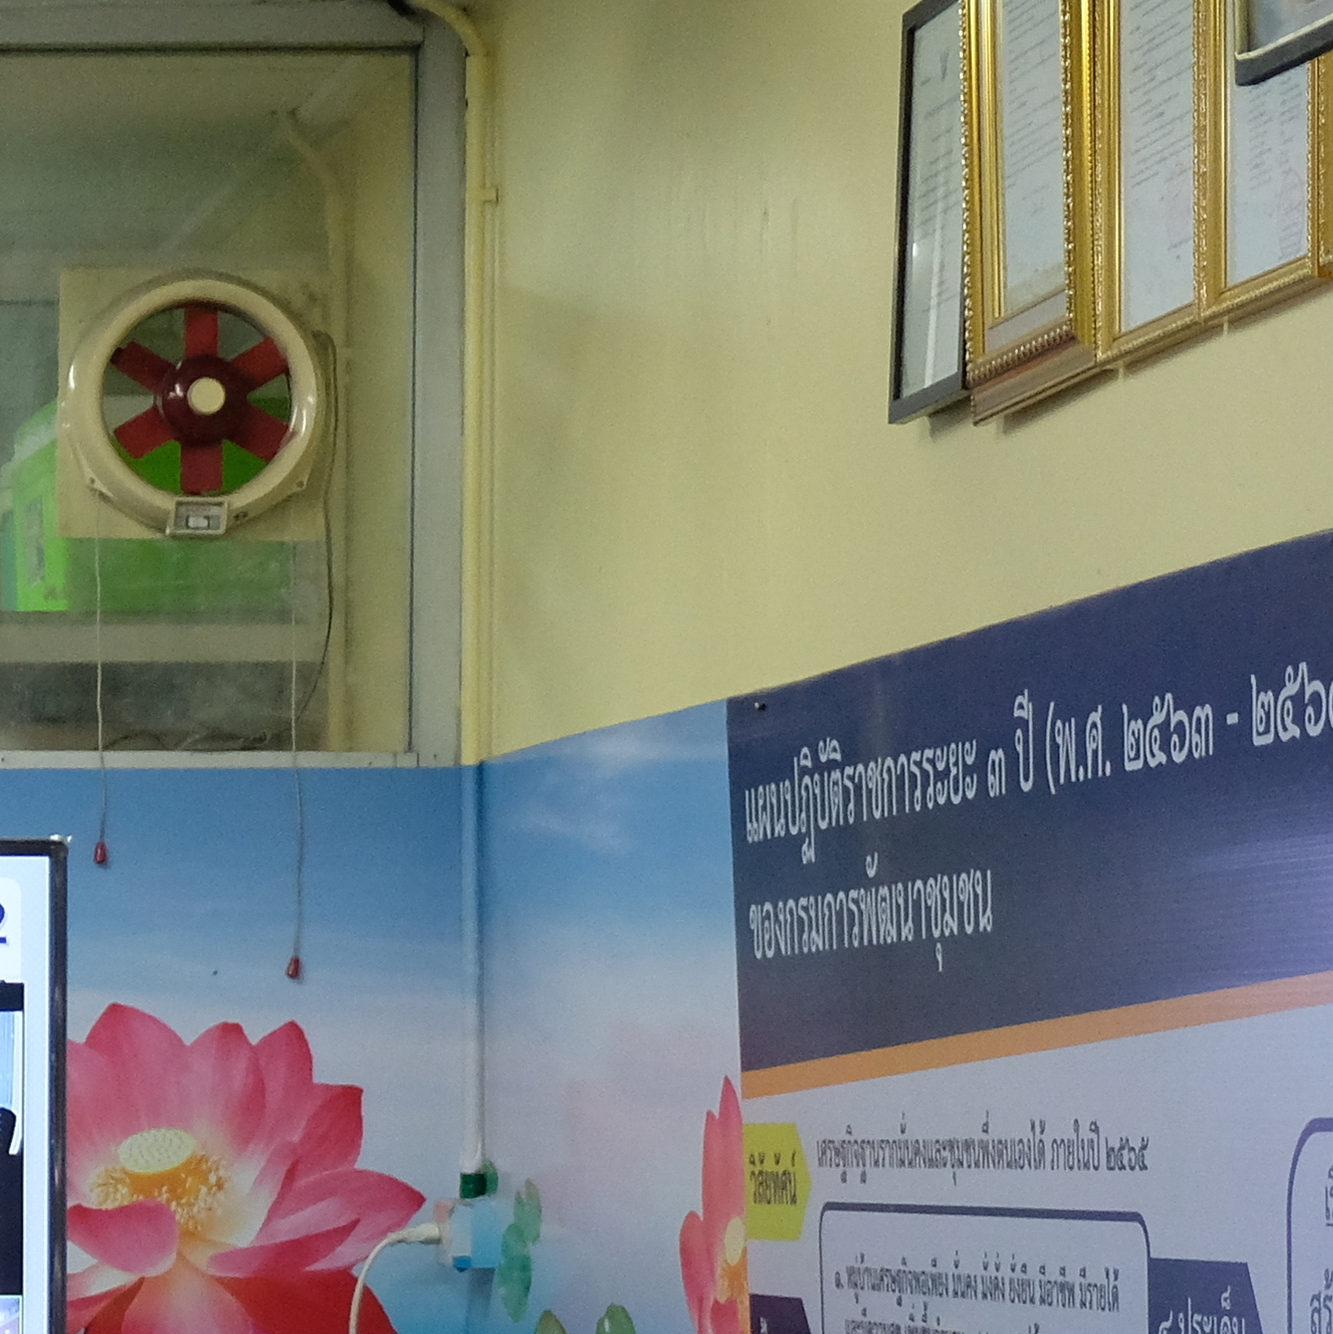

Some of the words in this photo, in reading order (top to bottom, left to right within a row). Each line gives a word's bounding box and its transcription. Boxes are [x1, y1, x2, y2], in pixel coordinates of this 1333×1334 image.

[744, 738, 978, 864] แผนปฏิบัติราชการระยะ
[987, 748, 1007, 798] ๓
[1014, 688, 1035, 793] ปี
[1045, 700, 1111, 796] (พ.ศ.
[1122, 692, 1215, 771] ๒๕๖๓
[748, 852, 994, 973] ของกรมการพัฒนาชุมชน
[1050, 1118, 1101, 1172] ภายในปี
[1105, 1136, 1150, 1172] ๒๕๖๕
